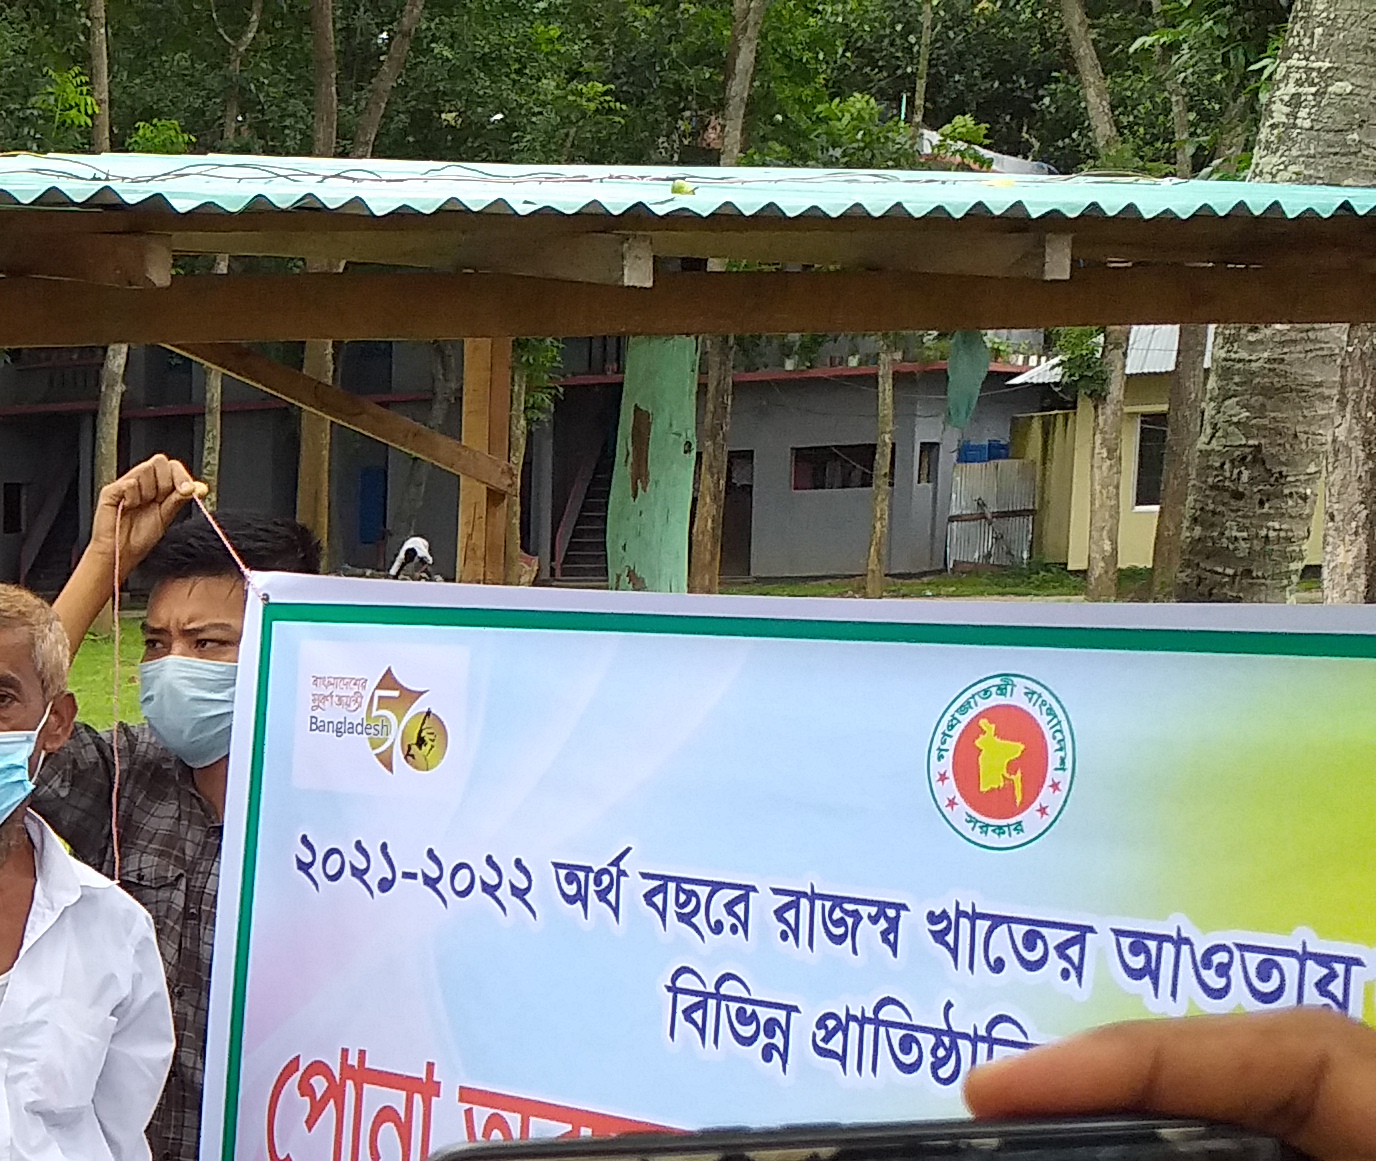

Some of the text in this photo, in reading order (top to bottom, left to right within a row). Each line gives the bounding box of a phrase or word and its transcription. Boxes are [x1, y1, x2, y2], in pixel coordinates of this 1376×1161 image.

[311, 674, 368, 691] বাংলাদেশের
[308, 715, 390, 738] Bangladesh
[1023, 686, 1068, 773] বাংলাদেশ
[964, 811, 1025, 838] সরকার
[294, 832, 1367, 1015] ২০২১-২০২২ অর্থ বছরে রাজস্ব খাতের আওতায়
[663, 965, 802, 1076] বিভিন্ন
